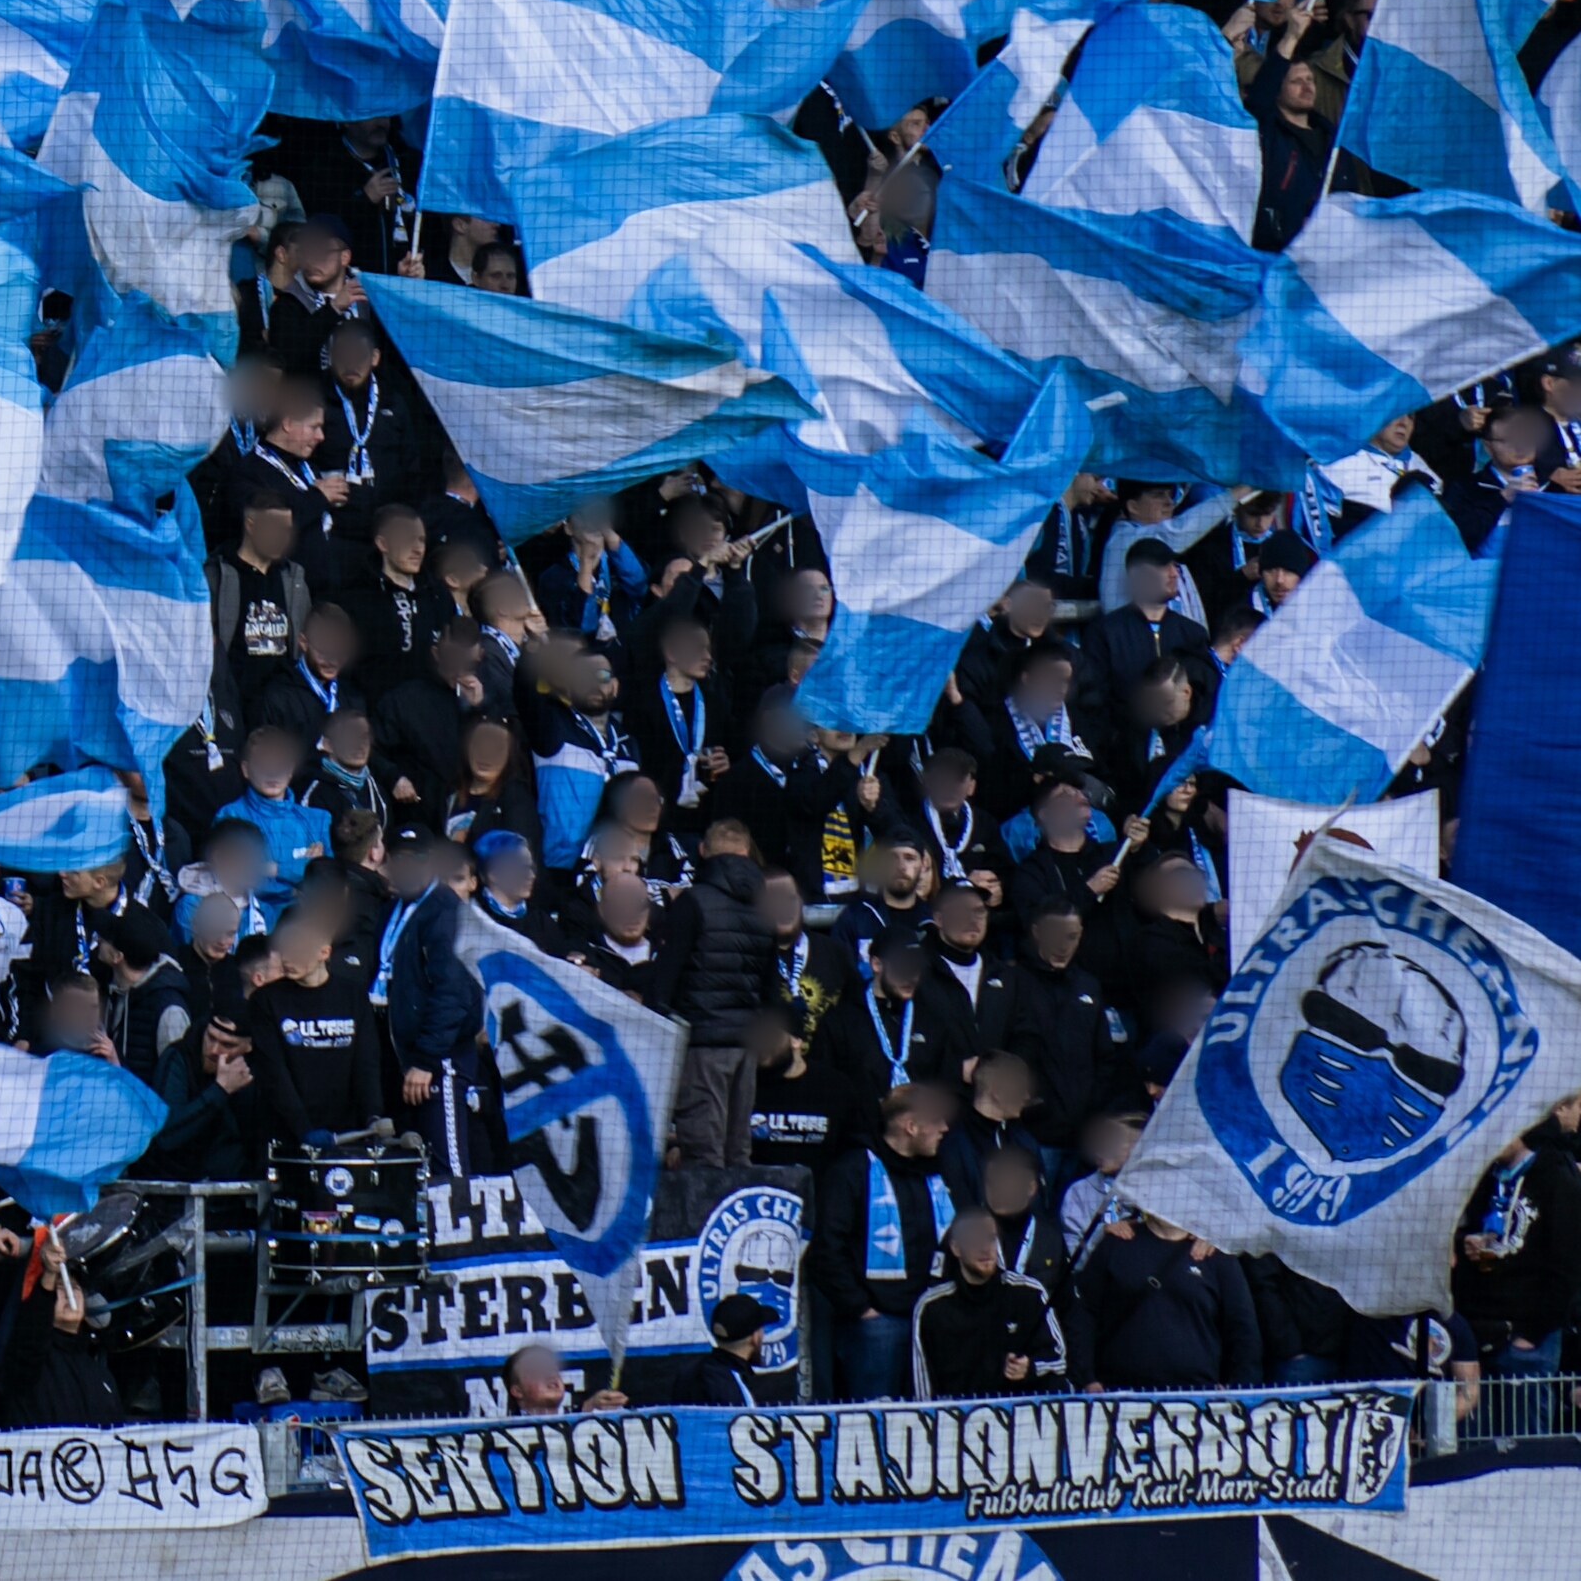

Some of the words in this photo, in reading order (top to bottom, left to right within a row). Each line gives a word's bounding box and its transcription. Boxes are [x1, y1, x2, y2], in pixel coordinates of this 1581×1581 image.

[701, 1197, 751, 1300] ULTRAS
[968, 1477, 1122, 1519] Fußballclub
[1131, 1467, 1340, 1509] Karl-Marx-Stadt
